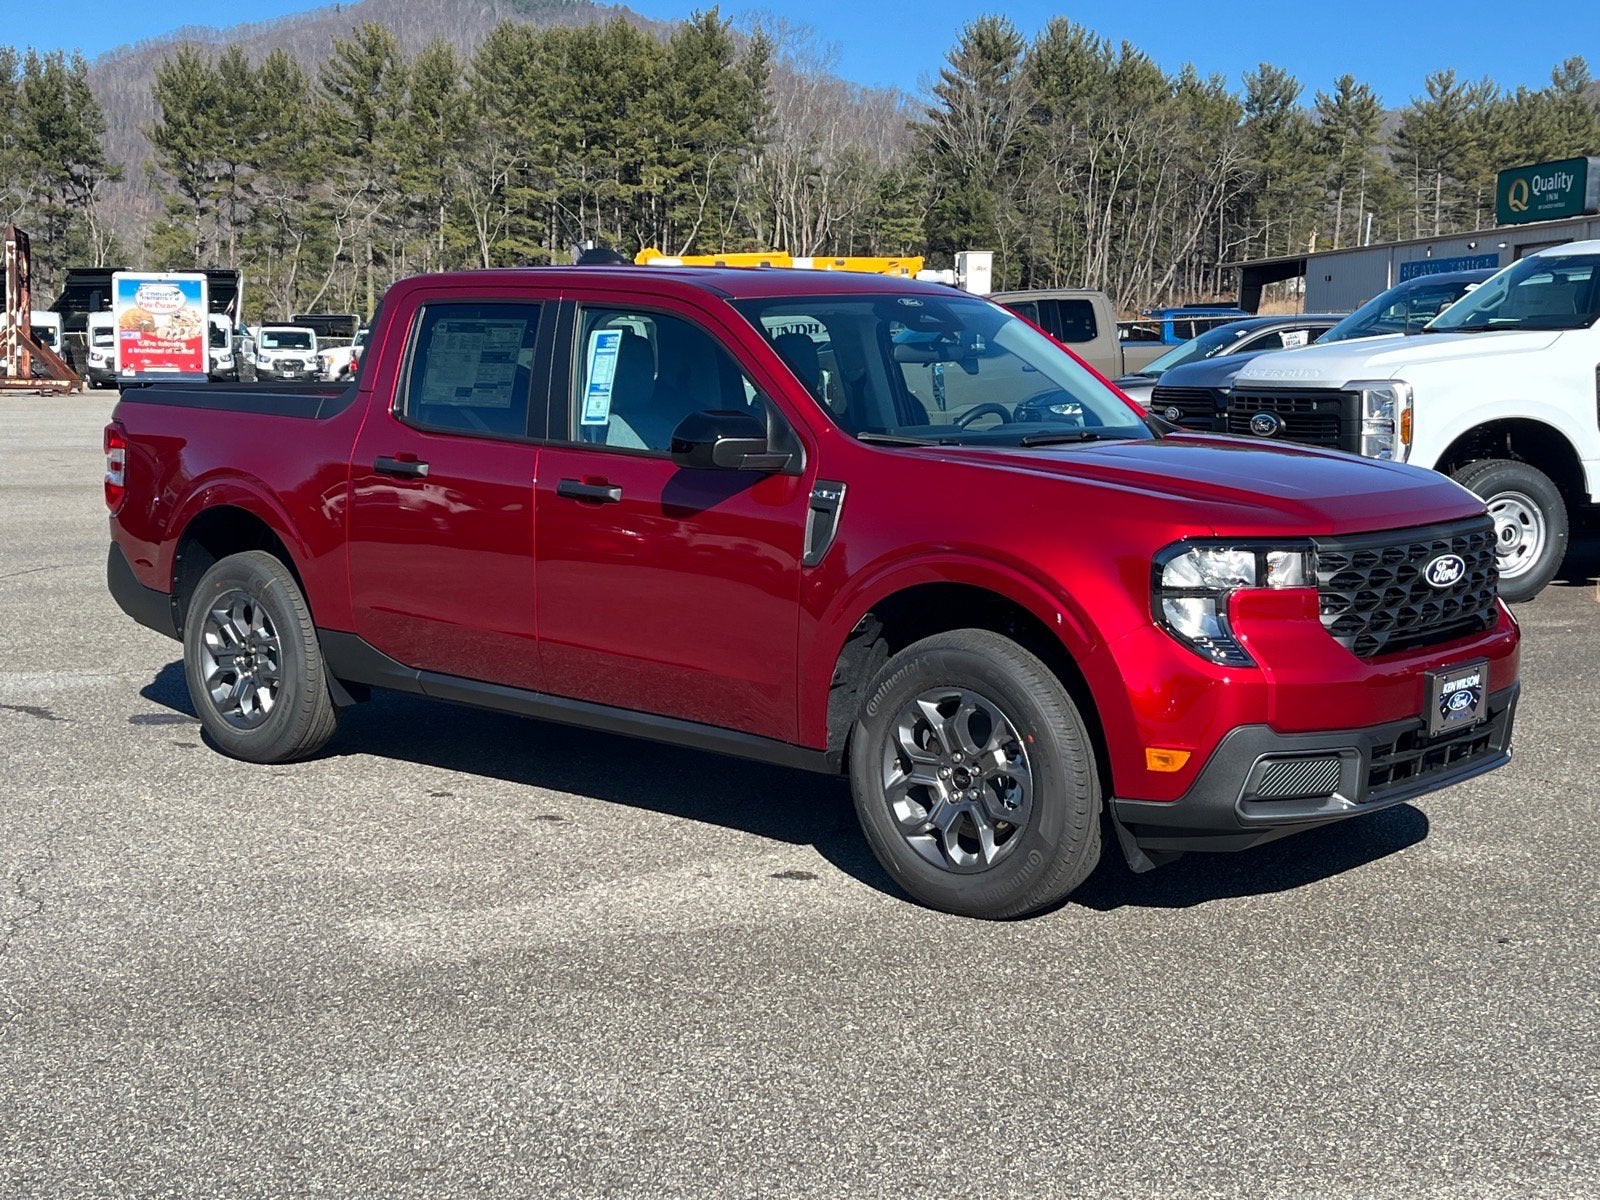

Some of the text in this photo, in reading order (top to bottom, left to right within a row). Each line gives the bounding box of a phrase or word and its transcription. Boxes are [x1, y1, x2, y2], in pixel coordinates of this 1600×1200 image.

[1532, 171, 1574, 196] Quality
[1546, 192, 1559, 202] INN
[1433, 558, 1460, 583] Ford
[866, 658, 921, 717] Continental
[1443, 674, 1480, 695] KEN WILSON
